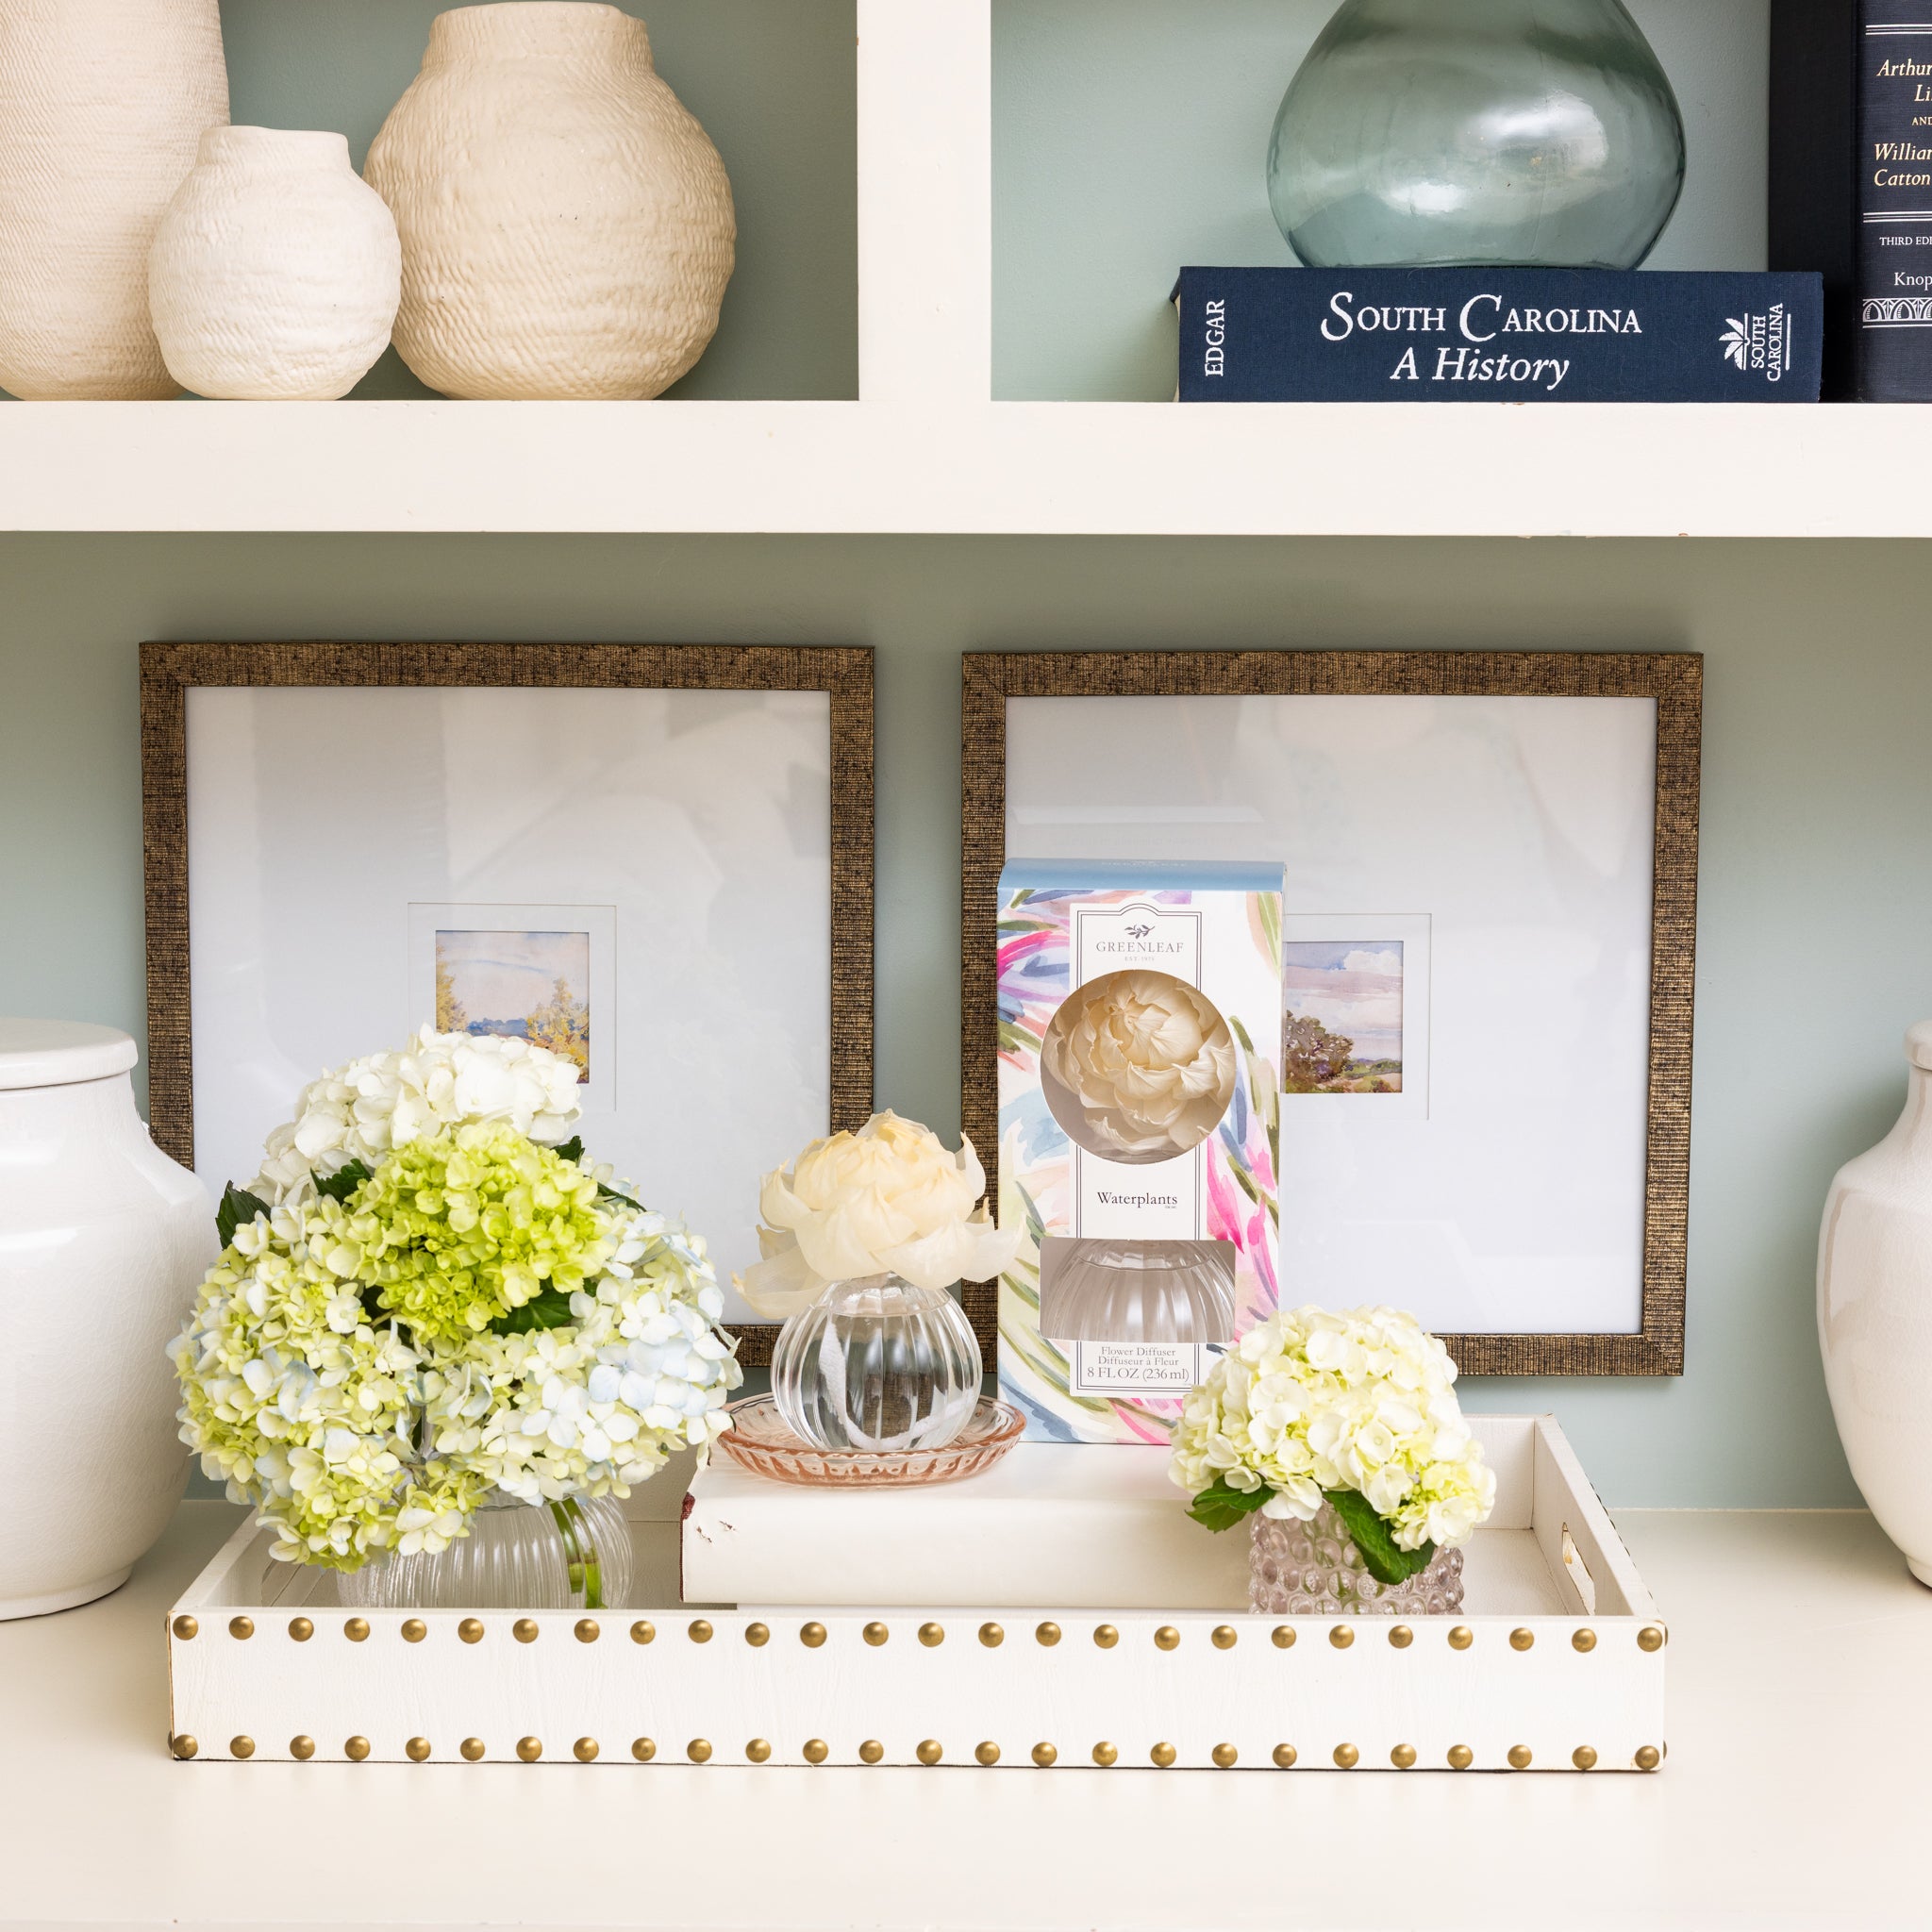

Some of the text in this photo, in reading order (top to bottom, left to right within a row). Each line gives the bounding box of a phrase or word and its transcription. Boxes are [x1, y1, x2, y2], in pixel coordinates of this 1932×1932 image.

[1875, 58, 1932, 76] Arthur
[1913, 84, 1932, 102] Li
[1874, 168, 1931, 187] Catton
[1878, 236, 1913, 246] THIRD
[1893, 272, 1932, 291] Knop
[1320, 291, 1643, 342] SOUTH CAROLINA
[1204, 298, 1225, 377] EDGAR
[1750, 315, 1767, 369] SOUTH
[1766, 302, 1784, 382] CAROLINA
[1389, 346, 1570, 389] A History
[1095, 941, 1184, 953] GREENLEAF
[1096, 1191, 1178, 1208] Waterplants
[1101, 1346, 1176, 1357] Flower Diffuser
[1098, 1356, 1179, 1366] Diffuseur à Fleur
[1087, 1367, 1094, 1378] 8
[1142, 1368, 1168, 1383] (236
[1170, 1368, 1190, 1383] ml)
